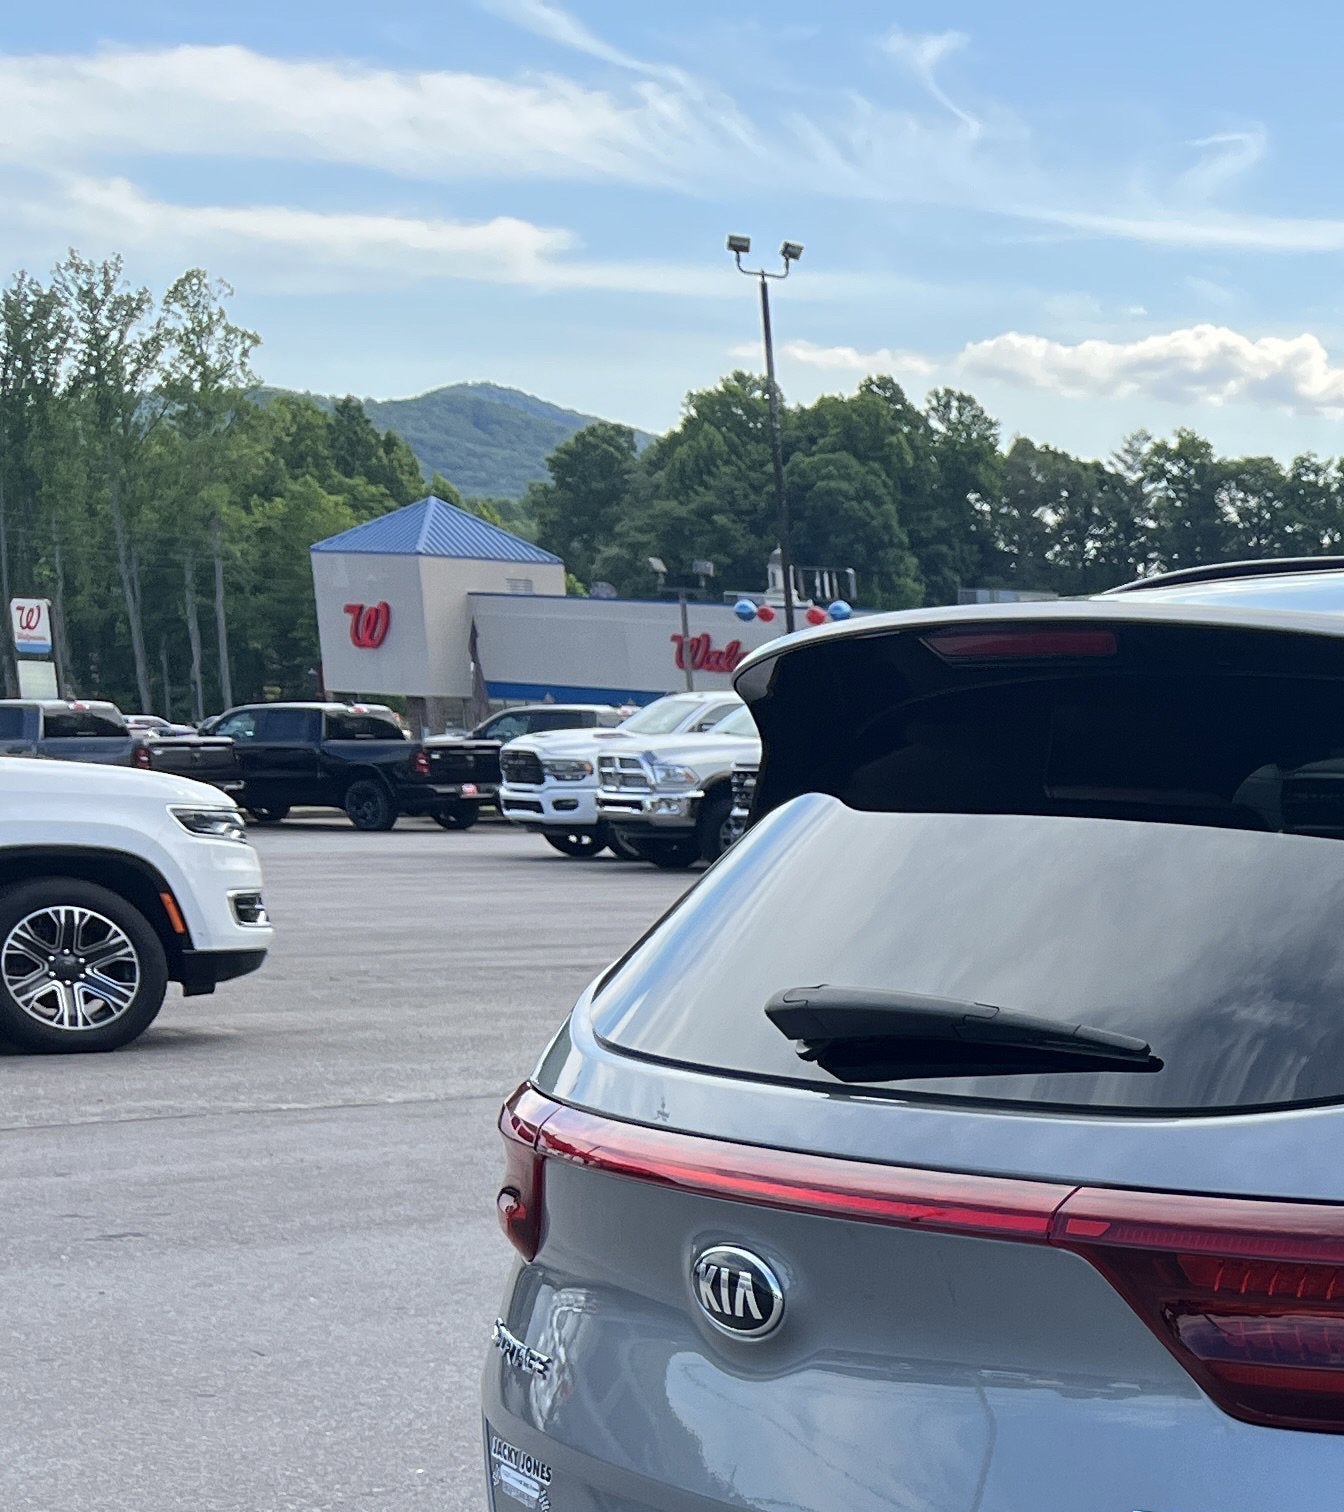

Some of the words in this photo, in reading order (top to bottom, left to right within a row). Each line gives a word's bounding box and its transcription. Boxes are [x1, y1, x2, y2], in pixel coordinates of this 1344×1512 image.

[16, 605, 41, 630] W
[343, 601, 390, 648] W
[698, 1262, 763, 1319] KIA
[492, 1436, 520, 1469] JACKY
[519, 1451, 552, 1486] JONES
